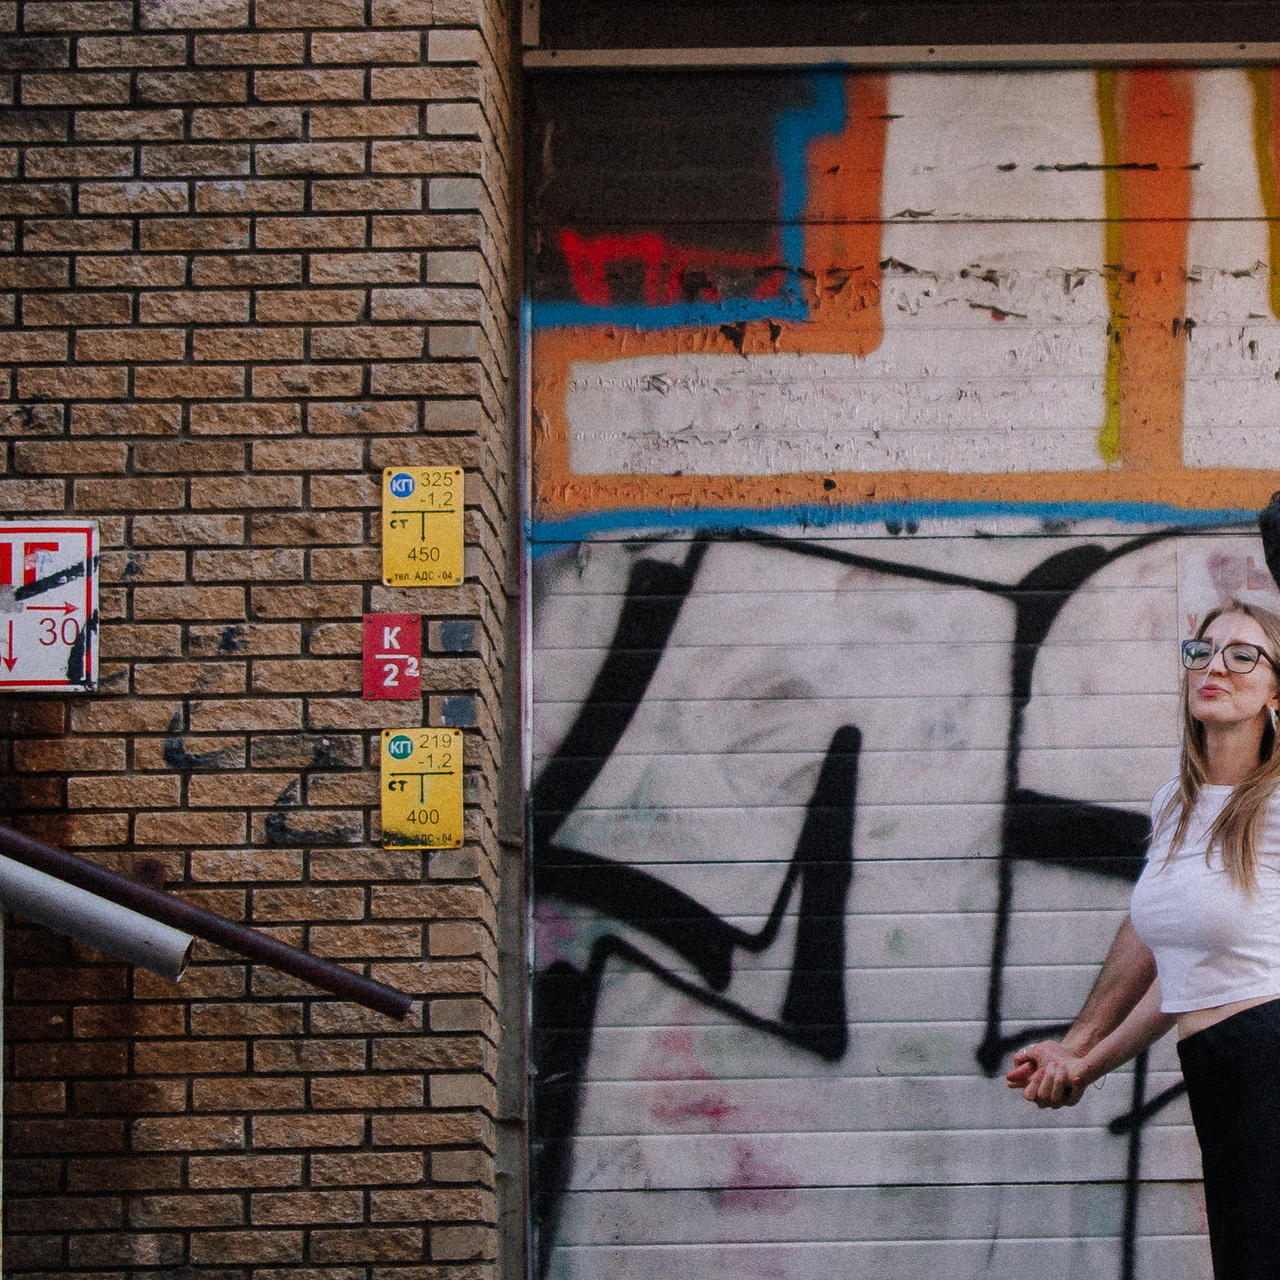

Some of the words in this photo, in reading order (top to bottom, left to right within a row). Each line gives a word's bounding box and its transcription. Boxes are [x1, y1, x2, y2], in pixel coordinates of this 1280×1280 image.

[391, 478, 413, 493] КП
[421, 471, 453, 487] 325
[420, 491, 453, 508] -1,2
[407, 547, 440, 562] 450
[394, 573, 413, 581] тел.
[415, 570, 434, 581] АДС
[442, 571, 453, 580] 04
[38, 617, 80, 646] 30
[383, 626, 401, 650] К
[383, 663, 399, 687] 2
[405, 656, 420, 677] 2
[390, 740, 411, 754] КП
[419, 733, 452, 749] 219
[418, 752, 452, 769] -1,2
[406, 808, 440, 825] 400
[442, 833, 452, 842] 04
